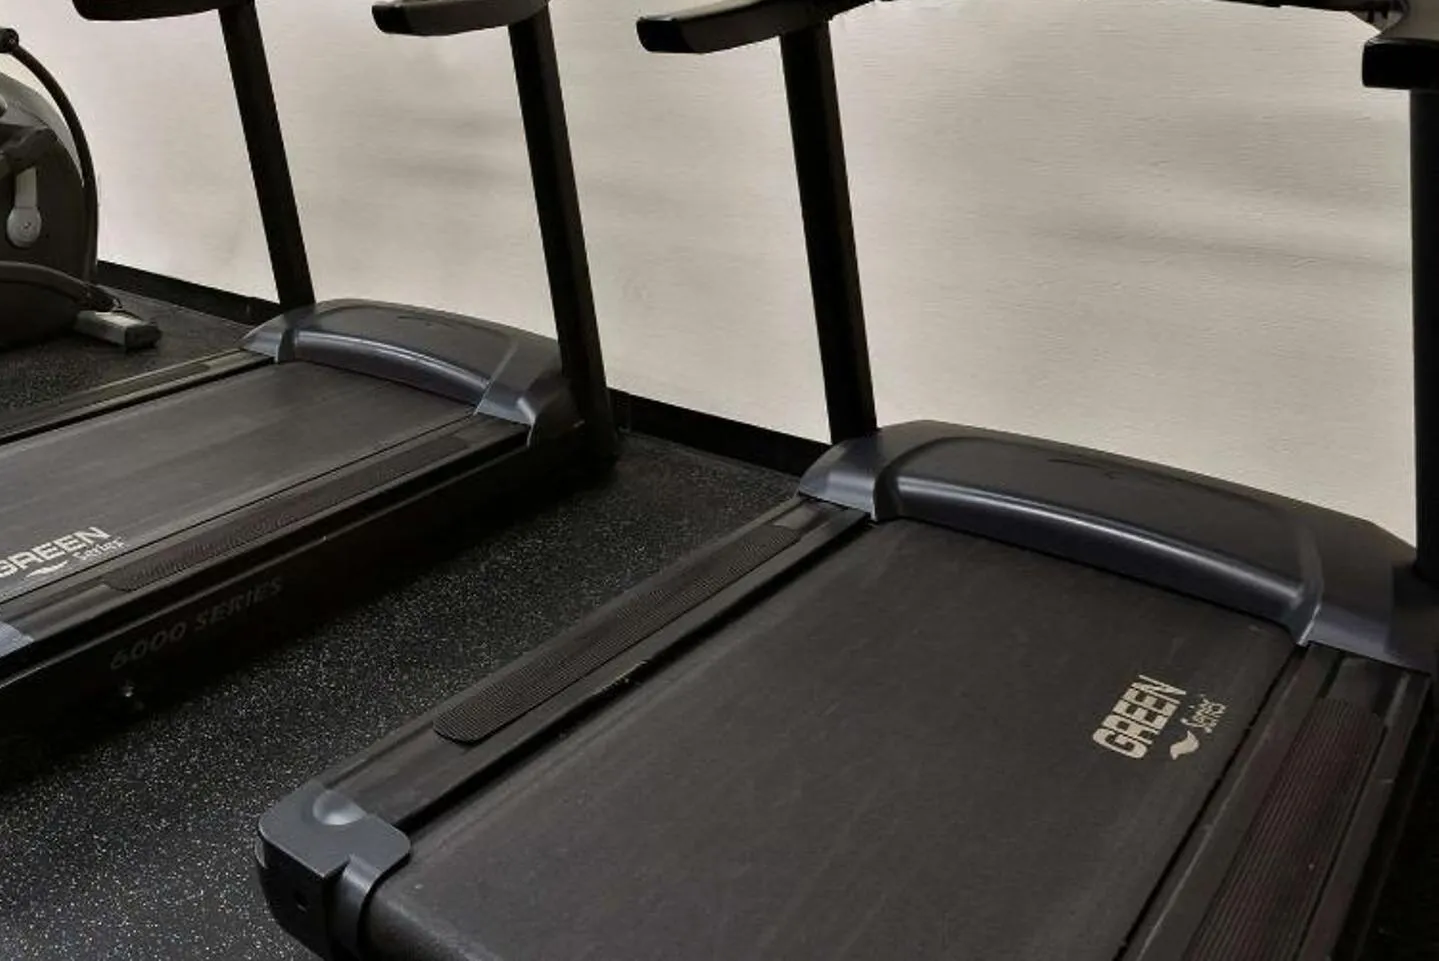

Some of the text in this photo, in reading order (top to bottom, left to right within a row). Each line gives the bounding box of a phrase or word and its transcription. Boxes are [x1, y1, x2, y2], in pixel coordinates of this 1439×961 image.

[110, 577, 283, 670] 6000 SERIES
[1092, 674, 1187, 759] GREEN
